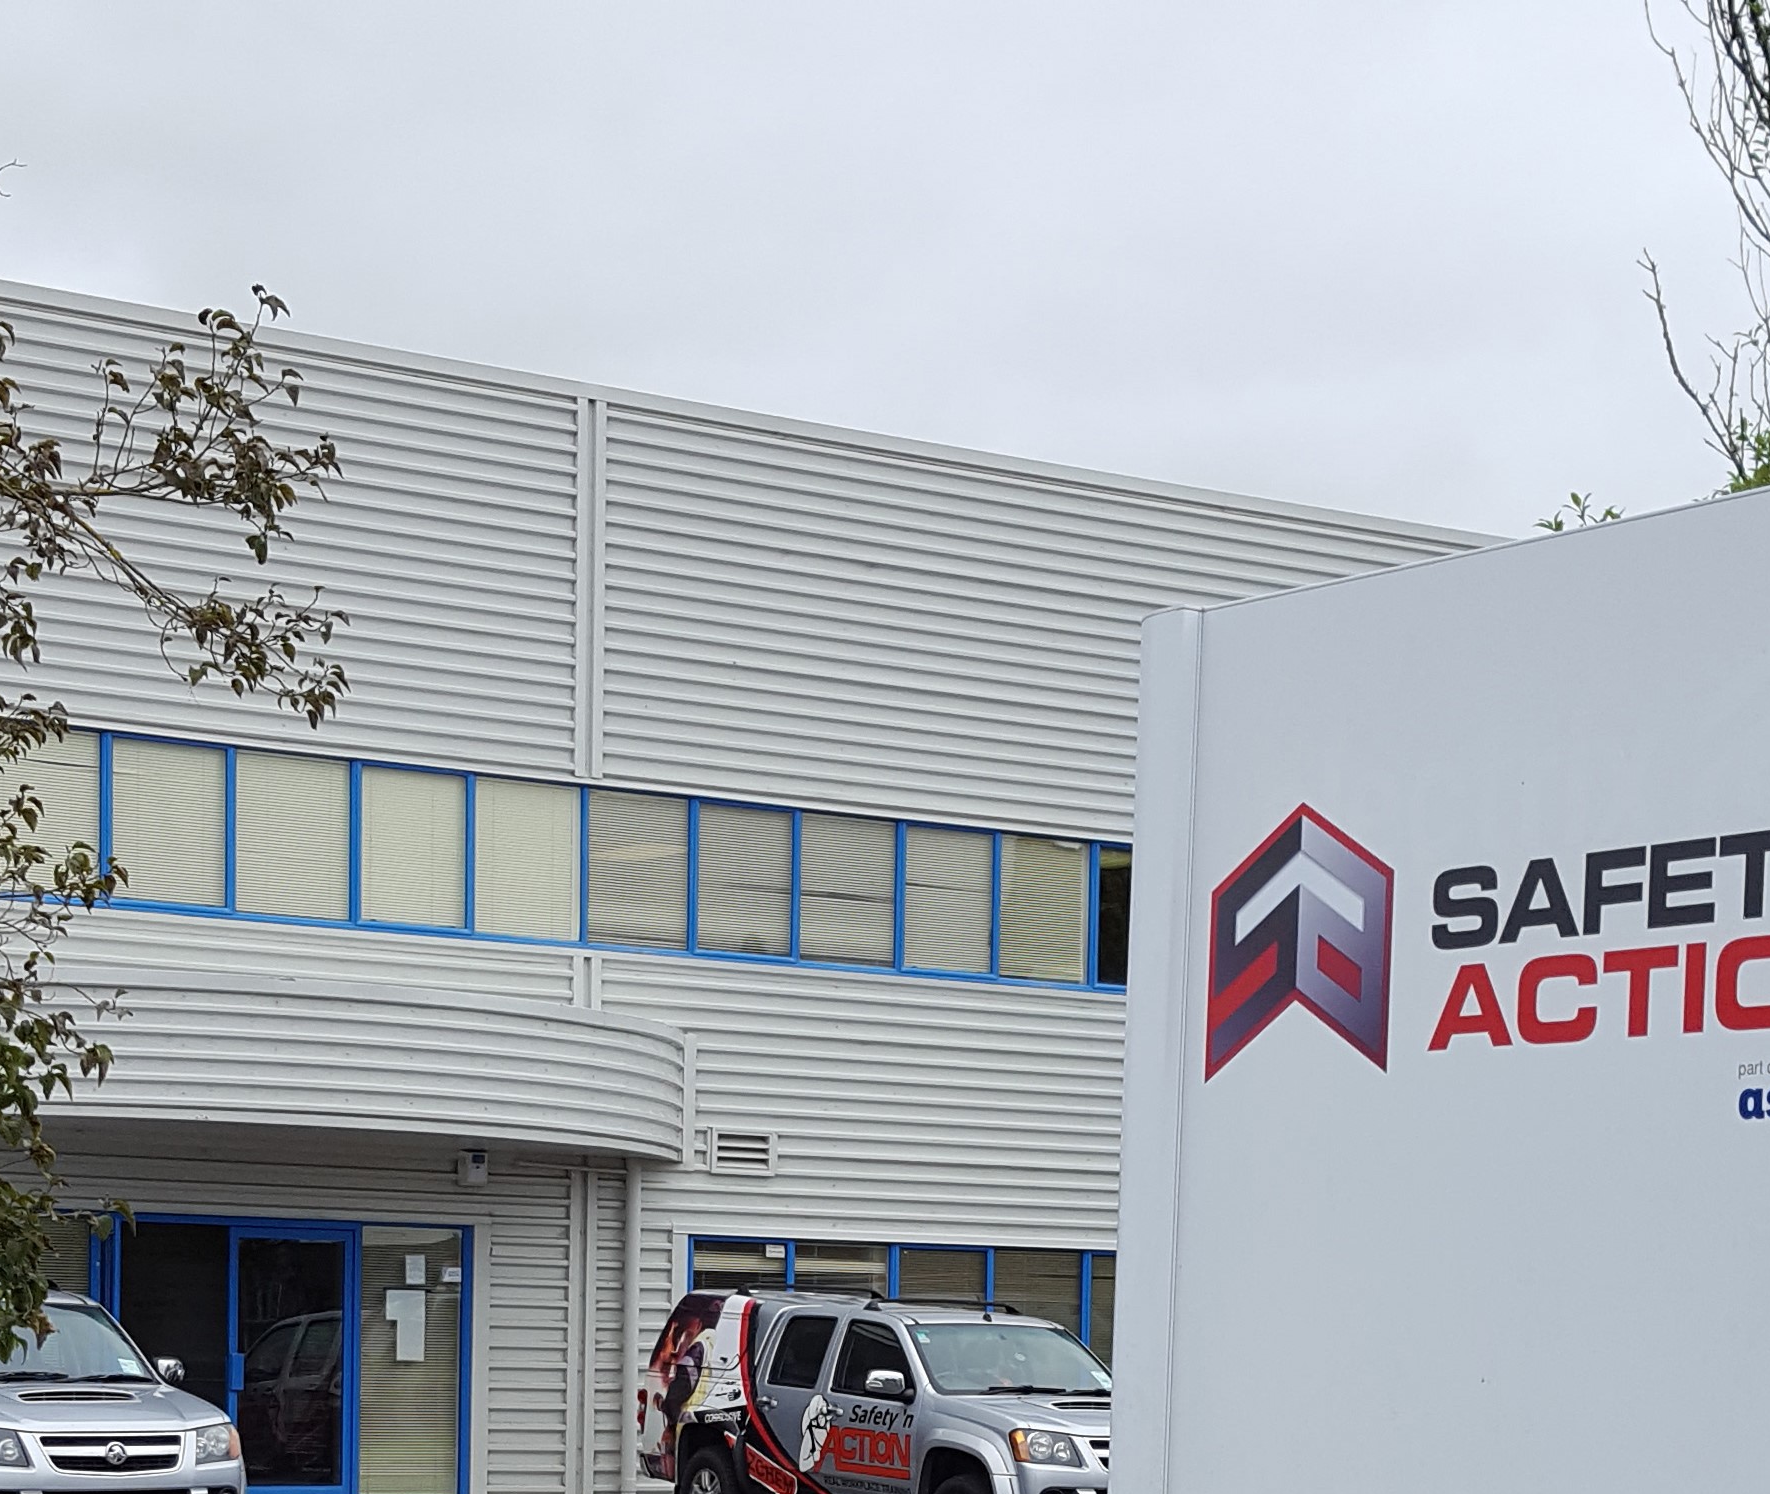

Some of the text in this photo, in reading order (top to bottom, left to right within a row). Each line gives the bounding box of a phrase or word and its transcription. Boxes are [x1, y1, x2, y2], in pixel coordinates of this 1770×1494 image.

[1738, 1060, 1763, 1079] part
[849, 1404, 899, 1431] Safety
[813, 1425, 912, 1474] ACTION
